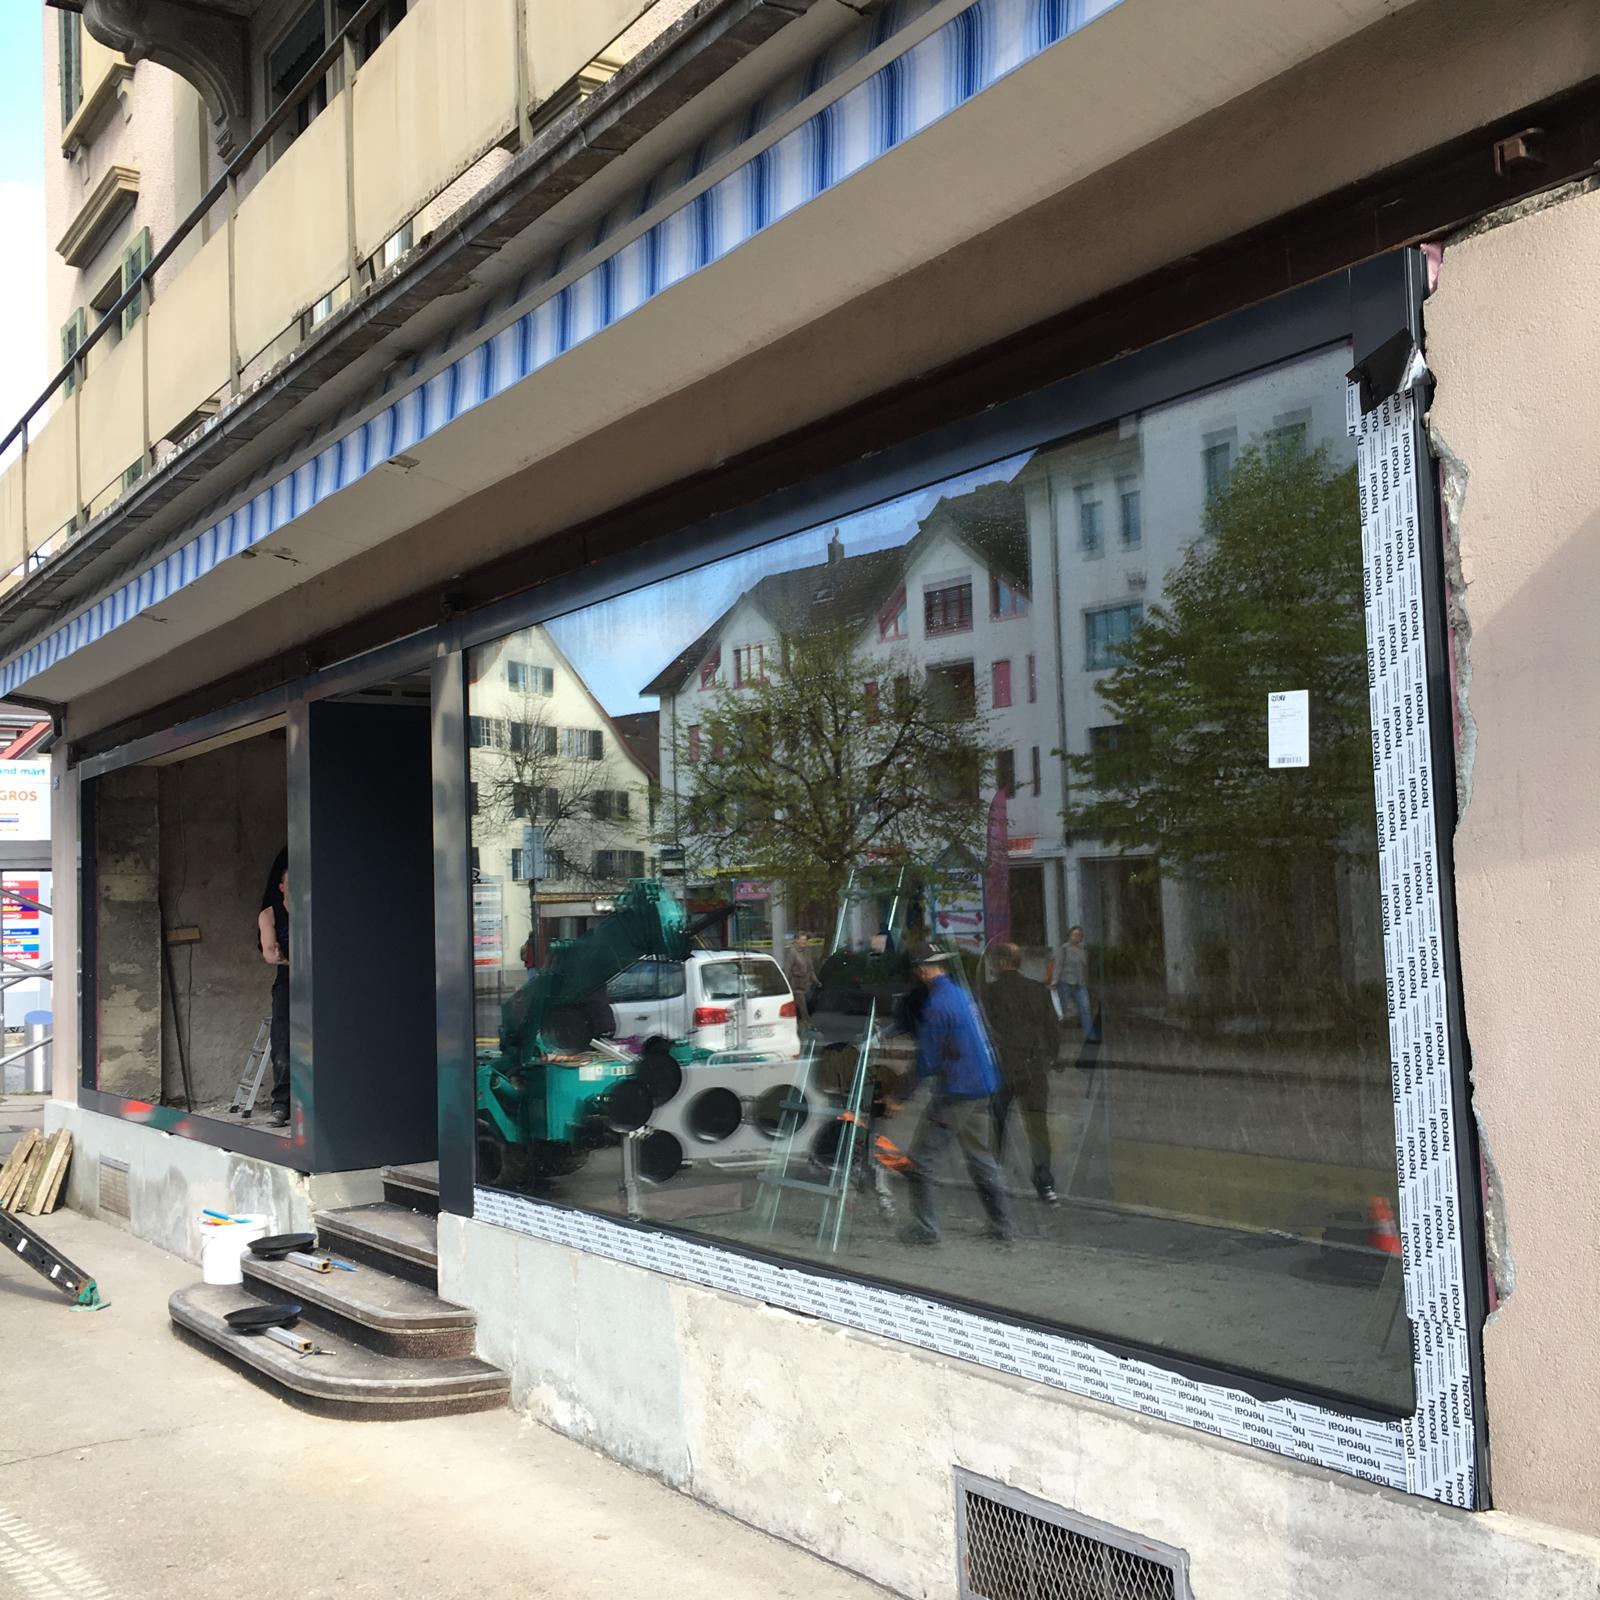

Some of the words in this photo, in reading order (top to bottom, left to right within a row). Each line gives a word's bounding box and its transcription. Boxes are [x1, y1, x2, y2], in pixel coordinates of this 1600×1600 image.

[1382, 398, 1391, 427] roal
[1393, 392, 1402, 413] oal
[1391, 446, 1400, 488] heroal
[1402, 432, 1411, 474] heroal
[1370, 472, 1379, 514] heroal
[1380, 460, 1389, 501] heroal
[1360, 485, 1368, 526] heroal
[1395, 530, 1404, 571] heroal
[1406, 517, 1415, 558] heroal
[1374, 555, 1382, 596] heroal
[1384, 542, 1393, 584] heroal
[1399, 612, 1408, 653] heroal
[1410, 599, 1419, 640] heroal
[1378, 636, 1386, 676] heroal
[1388, 624, 1397, 665] heroal
[1368, 648, 1376, 688] heroal
[1404, 694, 1413, 736] heroal
[1414, 682, 1424, 724] heroal
[1382, 718, 1392, 759] heroal
[1393, 706, 1402, 748] heroal
[1373, 730, 1381, 770] heroal
[1408, 778, 1418, 819] heroal
[1419, 766, 1429, 808] heroal
[1387, 800, 1396, 842] heroal
[1398, 789, 1407, 830] heroal
[1377, 812, 1386, 852] heroal
[1413, 862, 1423, 904] heroal
[1424, 851, 1434, 893] heroal
[1392, 884, 1401, 925] heroal
[1402, 873, 1412, 914] heroal
[1382, 895, 1390, 936] heroal
[1407, 957, 1417, 998] heroal
[1418, 946, 1428, 988] heroal
[1429, 936, 1439, 978] heroal
[1387, 977, 1396, 1019] heroal
[1396, 967, 1406, 1009] heroal
[1413, 1042, 1423, 1084] heroal
[1424, 1032, 1434, 1075] heroal
[1435, 1022, 1445, 1065] heroal
[1392, 1062, 1401, 1104] heroal
[1402, 1052, 1412, 1094] heroal
[1418, 1128, 1428, 1170] heroal
[1429, 1118, 1438, 1161] heroal
[1440, 1108, 1450, 1152] heroal
[1396, 1146, 1405, 1188] heroal
[1407, 1136, 1416, 1179] heroal
[1422, 1214, 1432, 1258] heroal
[1434, 1205, 1444, 1249] heroal
[1445, 1196, 1455, 1240] heroal
[1402, 1232, 1410, 1275] heroal
[1412, 1223, 1422, 1267] heroal
[943, 1315, 963, 1325] heroal
[1429, 1301, 1438, 1322] oal
[1450, 1284, 1461, 1328] heroal
[948, 1326, 968, 1337] heroal
[954, 1338, 974, 1350] heroal
[983, 1326, 1004, 1337] heroal
[989, 1338, 1010, 1349] heroal
[1026, 1337, 1048, 1349] heroal
[1064, 1338, 1088, 1350] heroal
[1424, 1320, 1433, 1356] eroal
[1435, 1321, 1444, 1348] roal
[959, 1351, 979, 1363] heroal
[994, 1350, 1016, 1362] heroal
[1000, 1363, 1021, 1375] heroal
[1032, 1350, 1054, 1362] heroal
[1038, 1363, 1060, 1375] heroal
[1071, 1350, 1095, 1362] heroal
[1077, 1363, 1101, 1376] heroal
[1120, 1362, 1145, 1376] heroal
[1044, 1376, 1067, 1389] heroal
[1084, 1376, 1108, 1390] heroal
[1090, 1390, 1114, 1404] heroal
[1126, 1376, 1152, 1390] heroal
[1133, 1390, 1159, 1404] heroal
[1171, 1377, 1198, 1391] heroal
[1179, 1391, 1206, 1406] heroal
[1227, 1391, 1256, 1407] heroal
[1462, 1374, 1472, 1420] heroal
[1140, 1404, 1166, 1420] heroal
[1186, 1405, 1214, 1420] heroal
[1235, 1407, 1264, 1422] heroal
[1428, 1400, 1438, 1444] heroal
[1439, 1392, 1450, 1436] heroal
[1450, 1384, 1460, 1428] heroal
[1193, 1420, 1221, 1435] heroal
[1243, 1422, 1272, 1437] heroal
[1251, 1436, 1281, 1454] heroal
[1329, 1422, 1362, 1438] heroal
[1338, 1437, 1371, 1454] heroal
[1386, 1422, 1402, 1432] oal
[1404, 1418, 1416, 1460] heroal
[1417, 1407, 1427, 1452] heroal
[1347, 1453, 1380, 1470] heroal
[1356, 1469, 1389, 1486] heroal
[1457, 1472, 1465, 1505] hero
